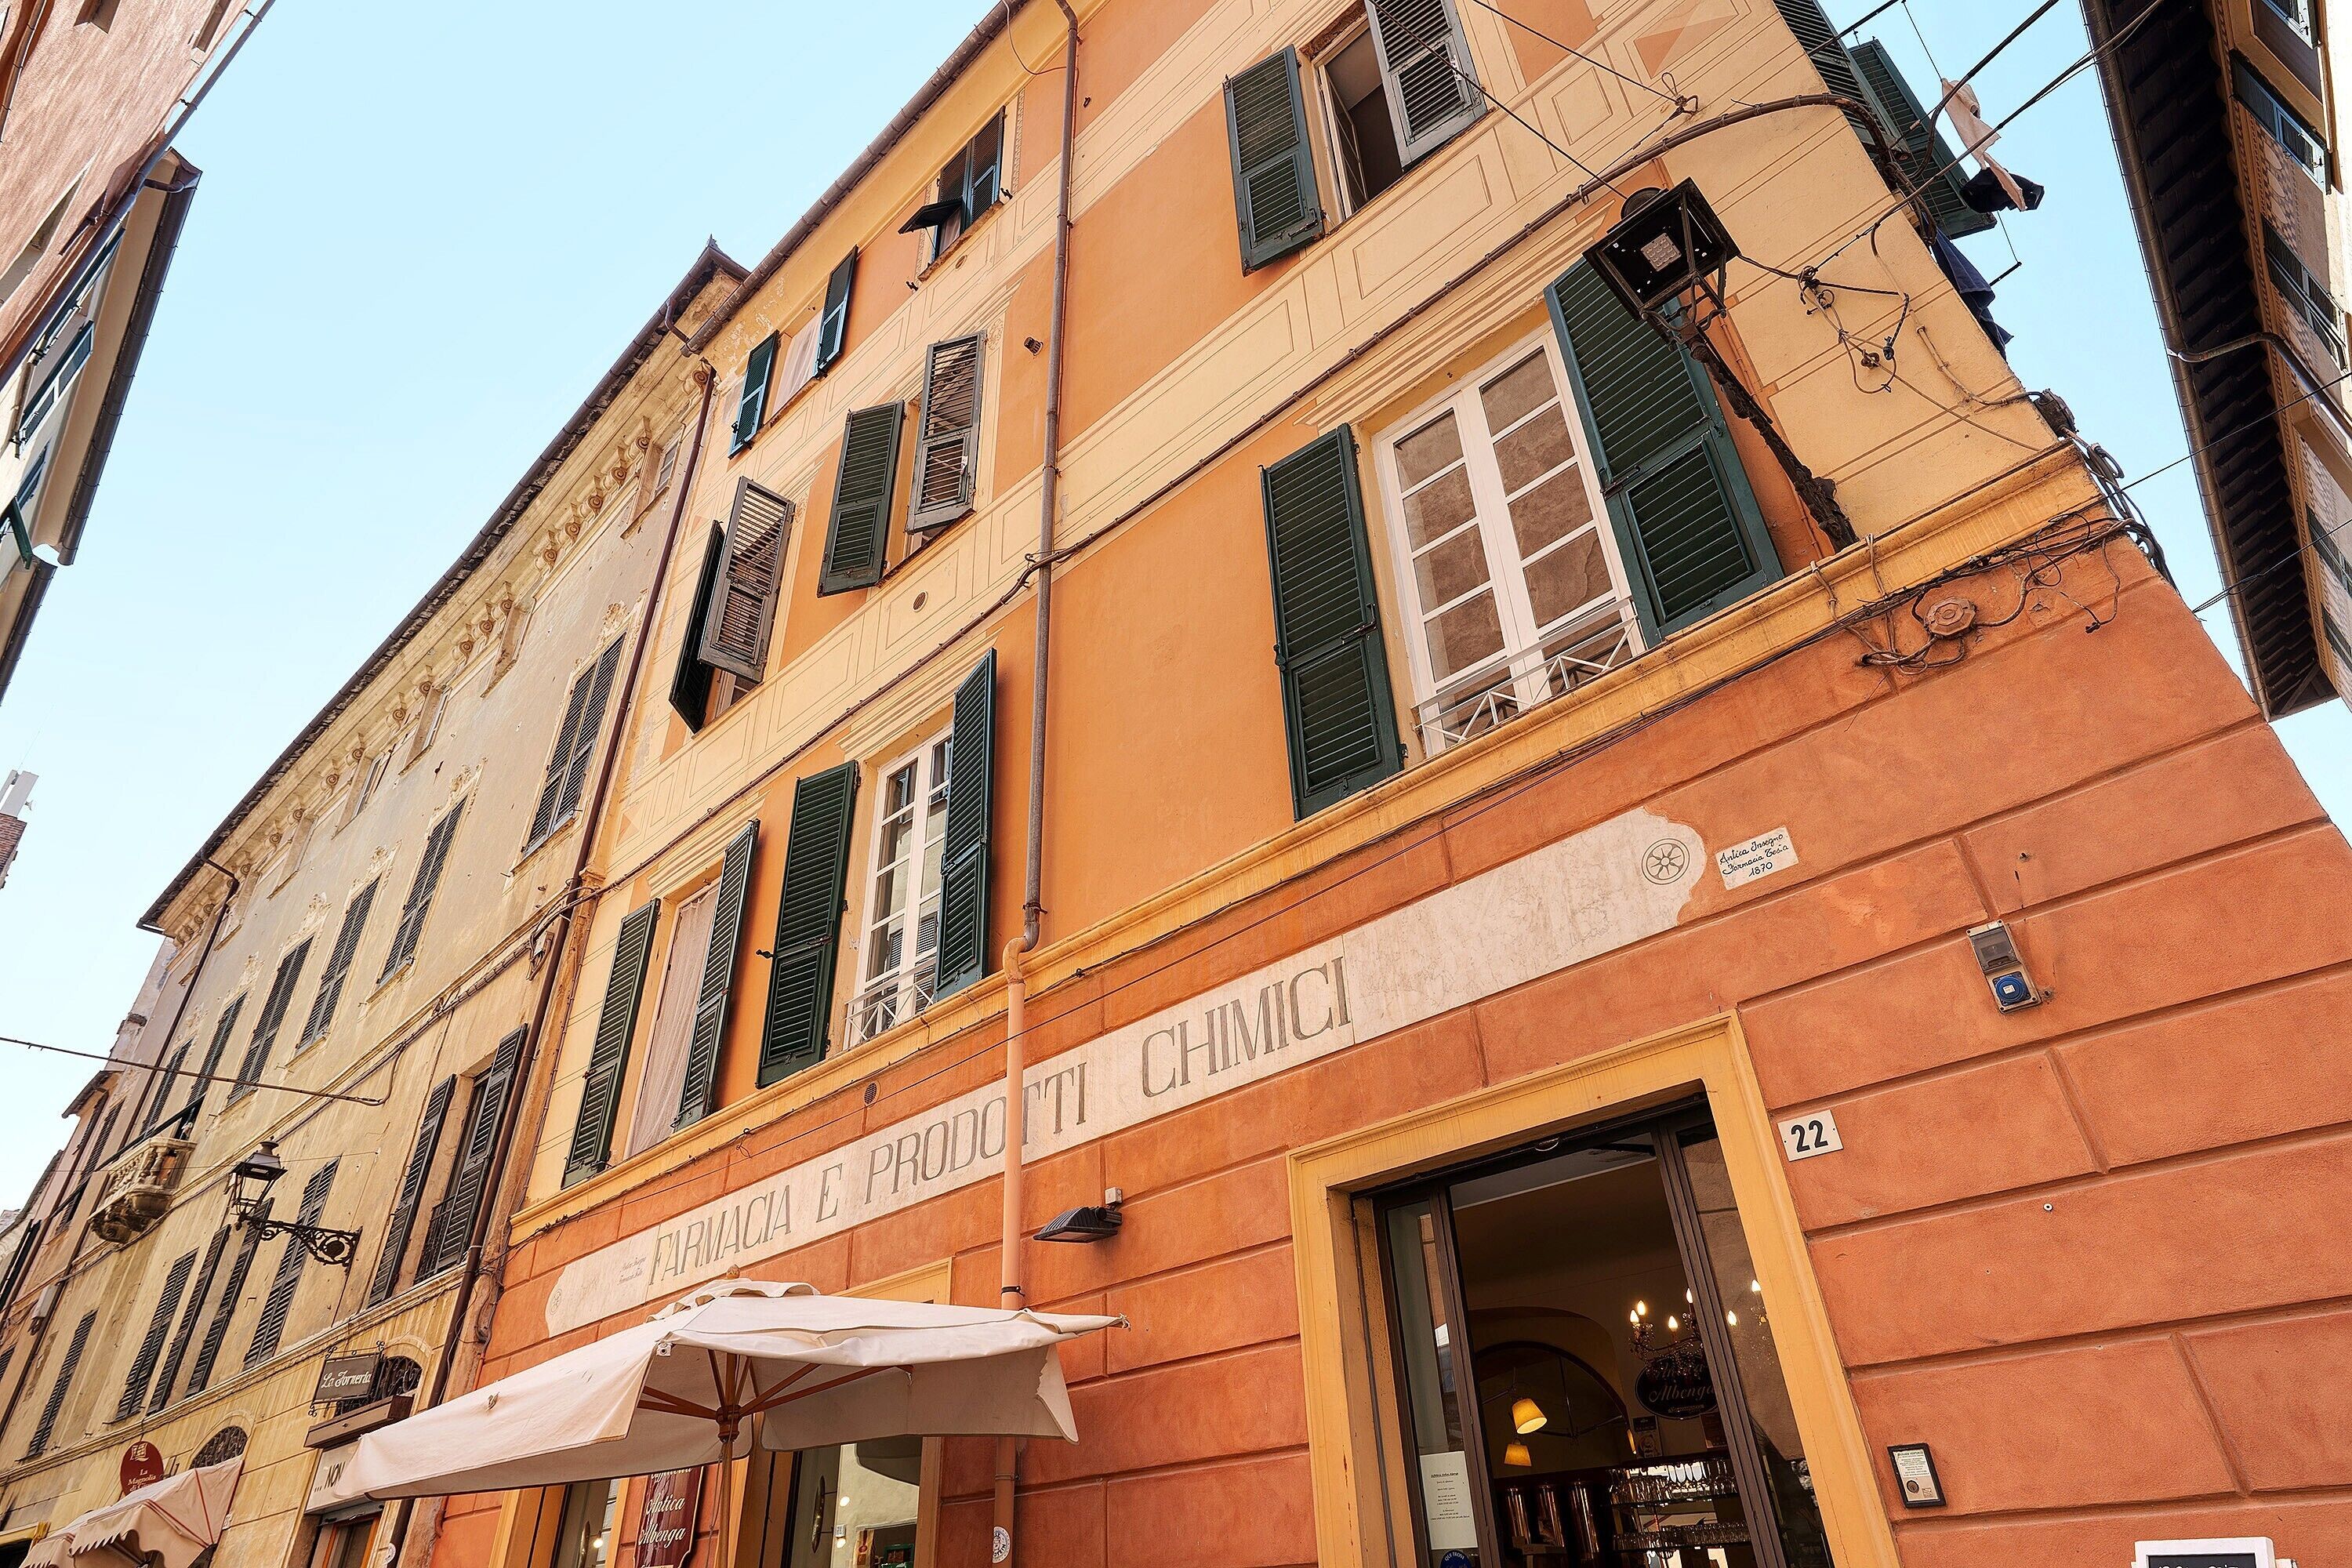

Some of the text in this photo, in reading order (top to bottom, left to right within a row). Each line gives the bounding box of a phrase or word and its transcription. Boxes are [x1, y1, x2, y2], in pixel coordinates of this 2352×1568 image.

[1719, 849, 1749, 866] Antica
[1722, 854, 1765, 875] Farmacia
[1748, 862, 1773, 877] 1870
[648, 955, 1352, 1286] FARMACIA E PRODOTTI CHIMICI
[1791, 1120, 1829, 1152] 22
[321, 1372, 336, 1388] La
[646, 1491, 686, 1515] Antica
[637, 1523, 686, 1548] Albenga
